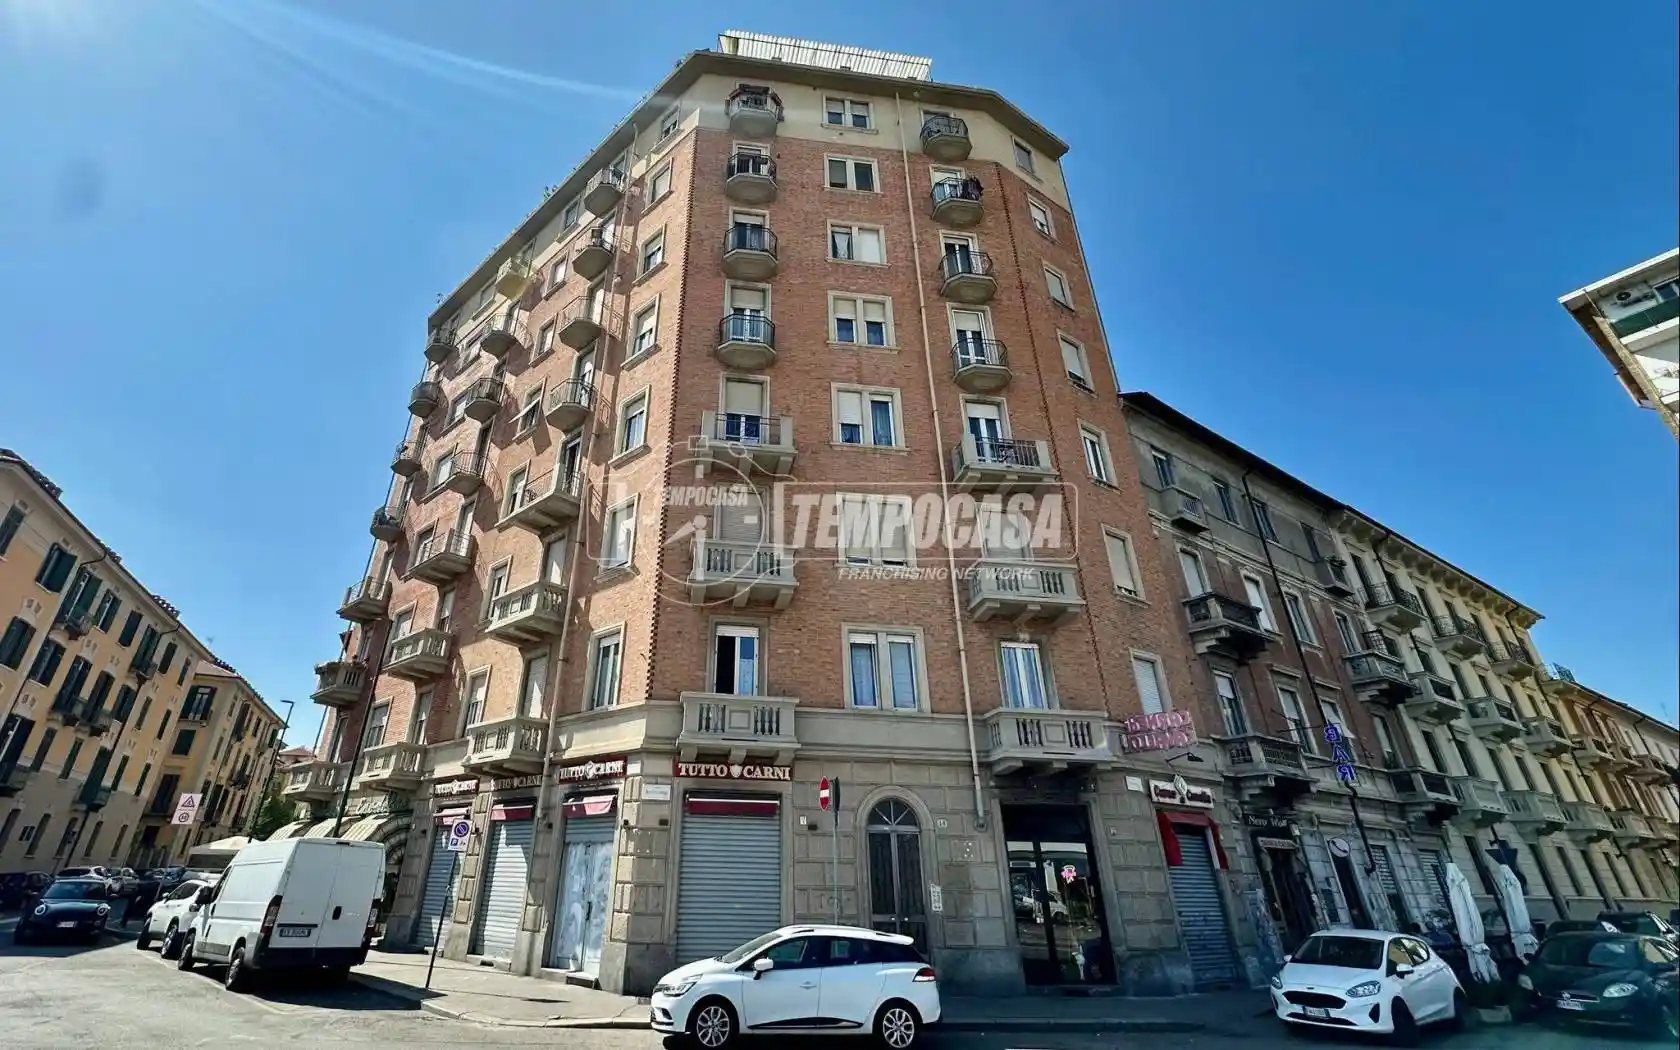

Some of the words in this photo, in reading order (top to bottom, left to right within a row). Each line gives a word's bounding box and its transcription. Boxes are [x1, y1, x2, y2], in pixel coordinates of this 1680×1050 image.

[559, 766, 585, 780] TUTTO
[593, 760, 624, 775] CARNI
[678, 762, 727, 777] TUTTO
[743, 765, 791, 781] CARNI
